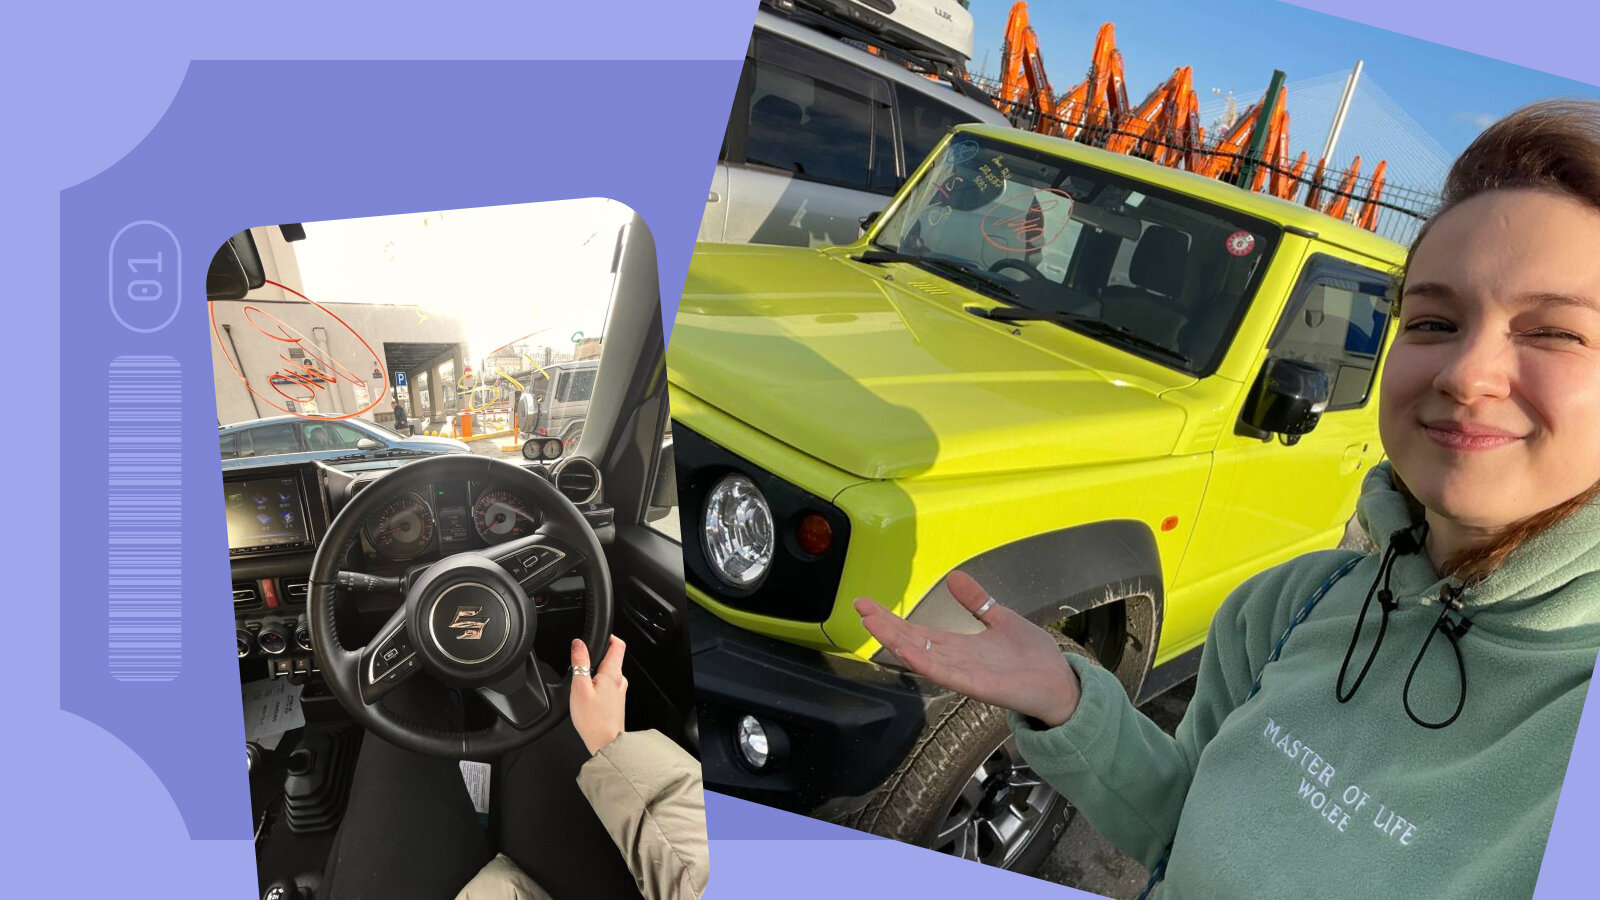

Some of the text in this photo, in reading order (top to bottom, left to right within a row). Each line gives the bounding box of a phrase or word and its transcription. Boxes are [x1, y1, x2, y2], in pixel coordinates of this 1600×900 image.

[934, 6, 953, 22] LUX
[1263, 717, 1417, 845] MASTER OF LIFE
[1298, 777, 1351, 832] WOLEE
